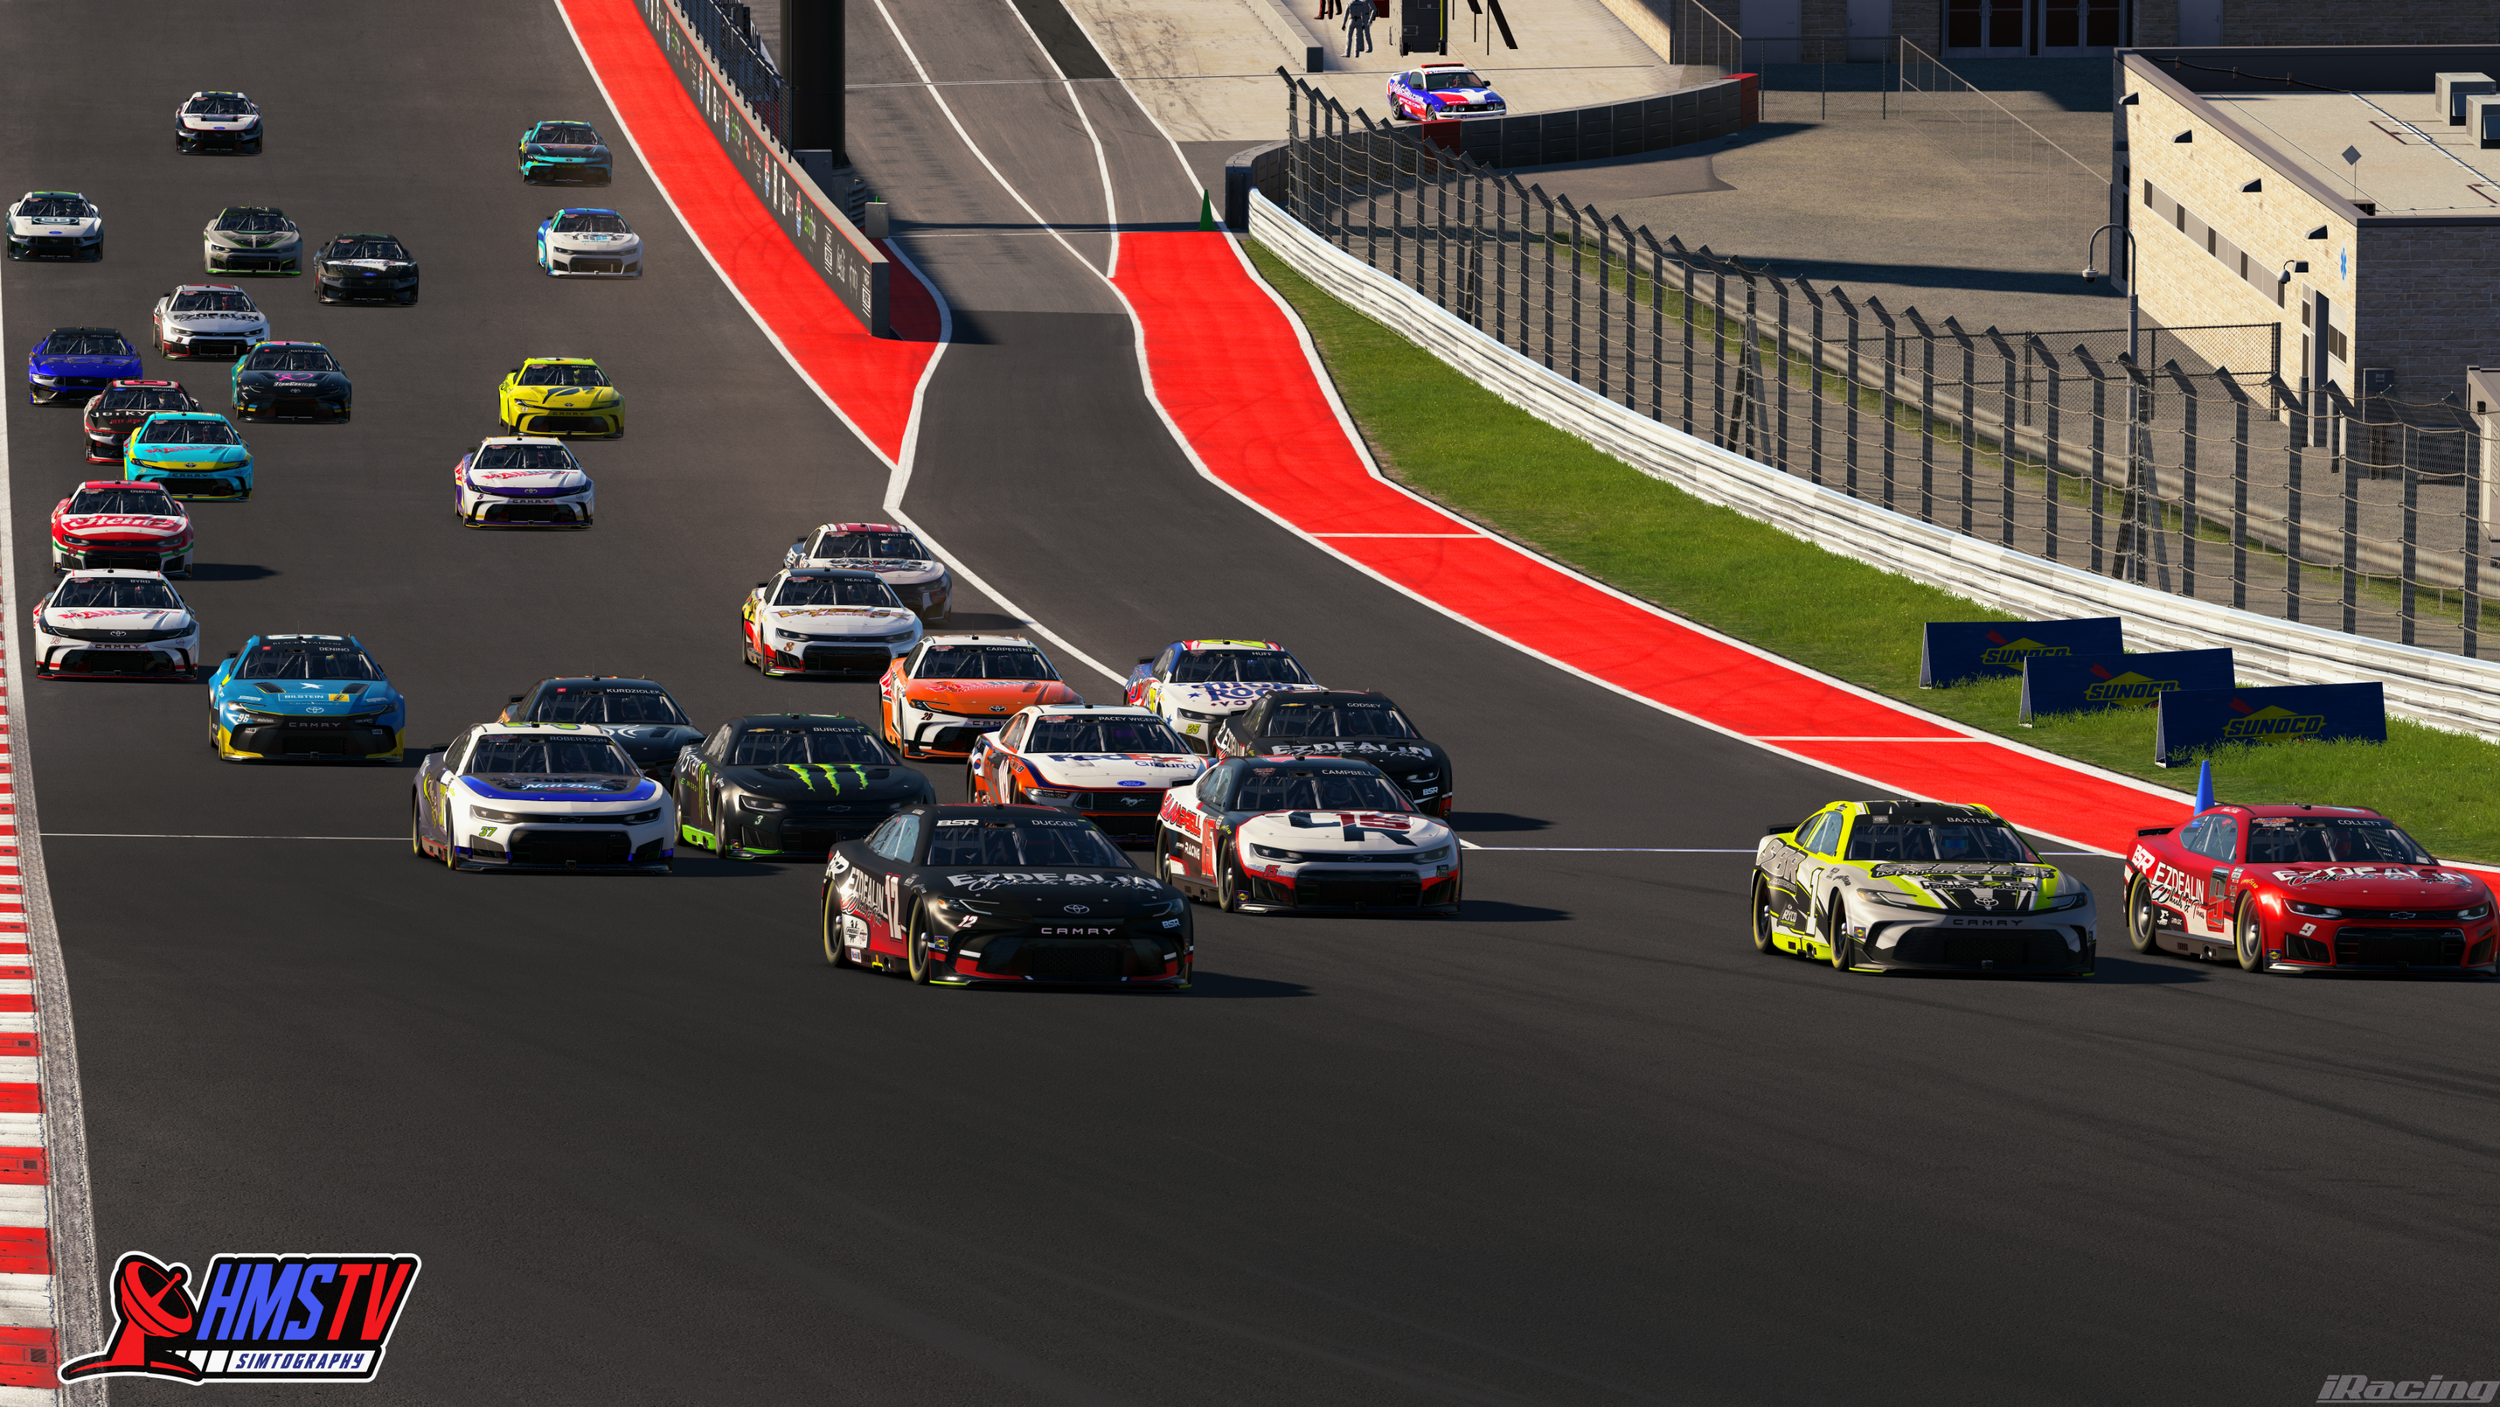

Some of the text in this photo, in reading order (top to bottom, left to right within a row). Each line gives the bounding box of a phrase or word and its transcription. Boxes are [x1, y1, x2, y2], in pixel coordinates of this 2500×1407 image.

[783, 642, 795, 651] 8
[1982, 646, 2071, 664] SUNOCO
[2086, 681, 2180, 700] SUNOCO
[237, 713, 250, 723] 96
[921, 712, 934, 721] 28
[1185, 723, 1201, 734] 25
[2224, 715, 2325, 736] SUNOCO
[550, 735, 607, 743] ROBERTSON
[1271, 741, 1433, 758] EZDEALIN
[1134, 760, 1197, 770] Ground
[1321, 768, 1375, 777] CAMPBELL
[1422, 786, 1438, 796] BSR
[754, 814, 764, 826] 3
[936, 819, 979, 827] BSR
[1031, 819, 1078, 827] DUGGER
[1946, 816, 1991, 825] BAXTER
[2337, 818, 2381, 827] COLLETT
[478, 826, 497, 837] 37
[1202, 816, 1217, 879] 15
[2131, 844, 2156, 875] BSR
[1263, 864, 1281, 877] 15
[2271, 866, 2473, 884] EZDEALIN
[946, 872, 1163, 890] EZDEALIN
[2151, 861, 2205, 905] EZDEALIN
[840, 866, 885, 915] EZDEALIN
[1805, 866, 1826, 938] 1
[2205, 866, 2232, 931] 9
[885, 872, 903, 942] 12
[957, 914, 979, 928] 12
[1161, 918, 1181, 929] BSR
[1953, 918, 2024, 926] CAMRY
[1041, 927, 1116, 935] CAMRY
[2298, 922, 2318, 937] 9
[2477, 925, 2493, 939] BSR
